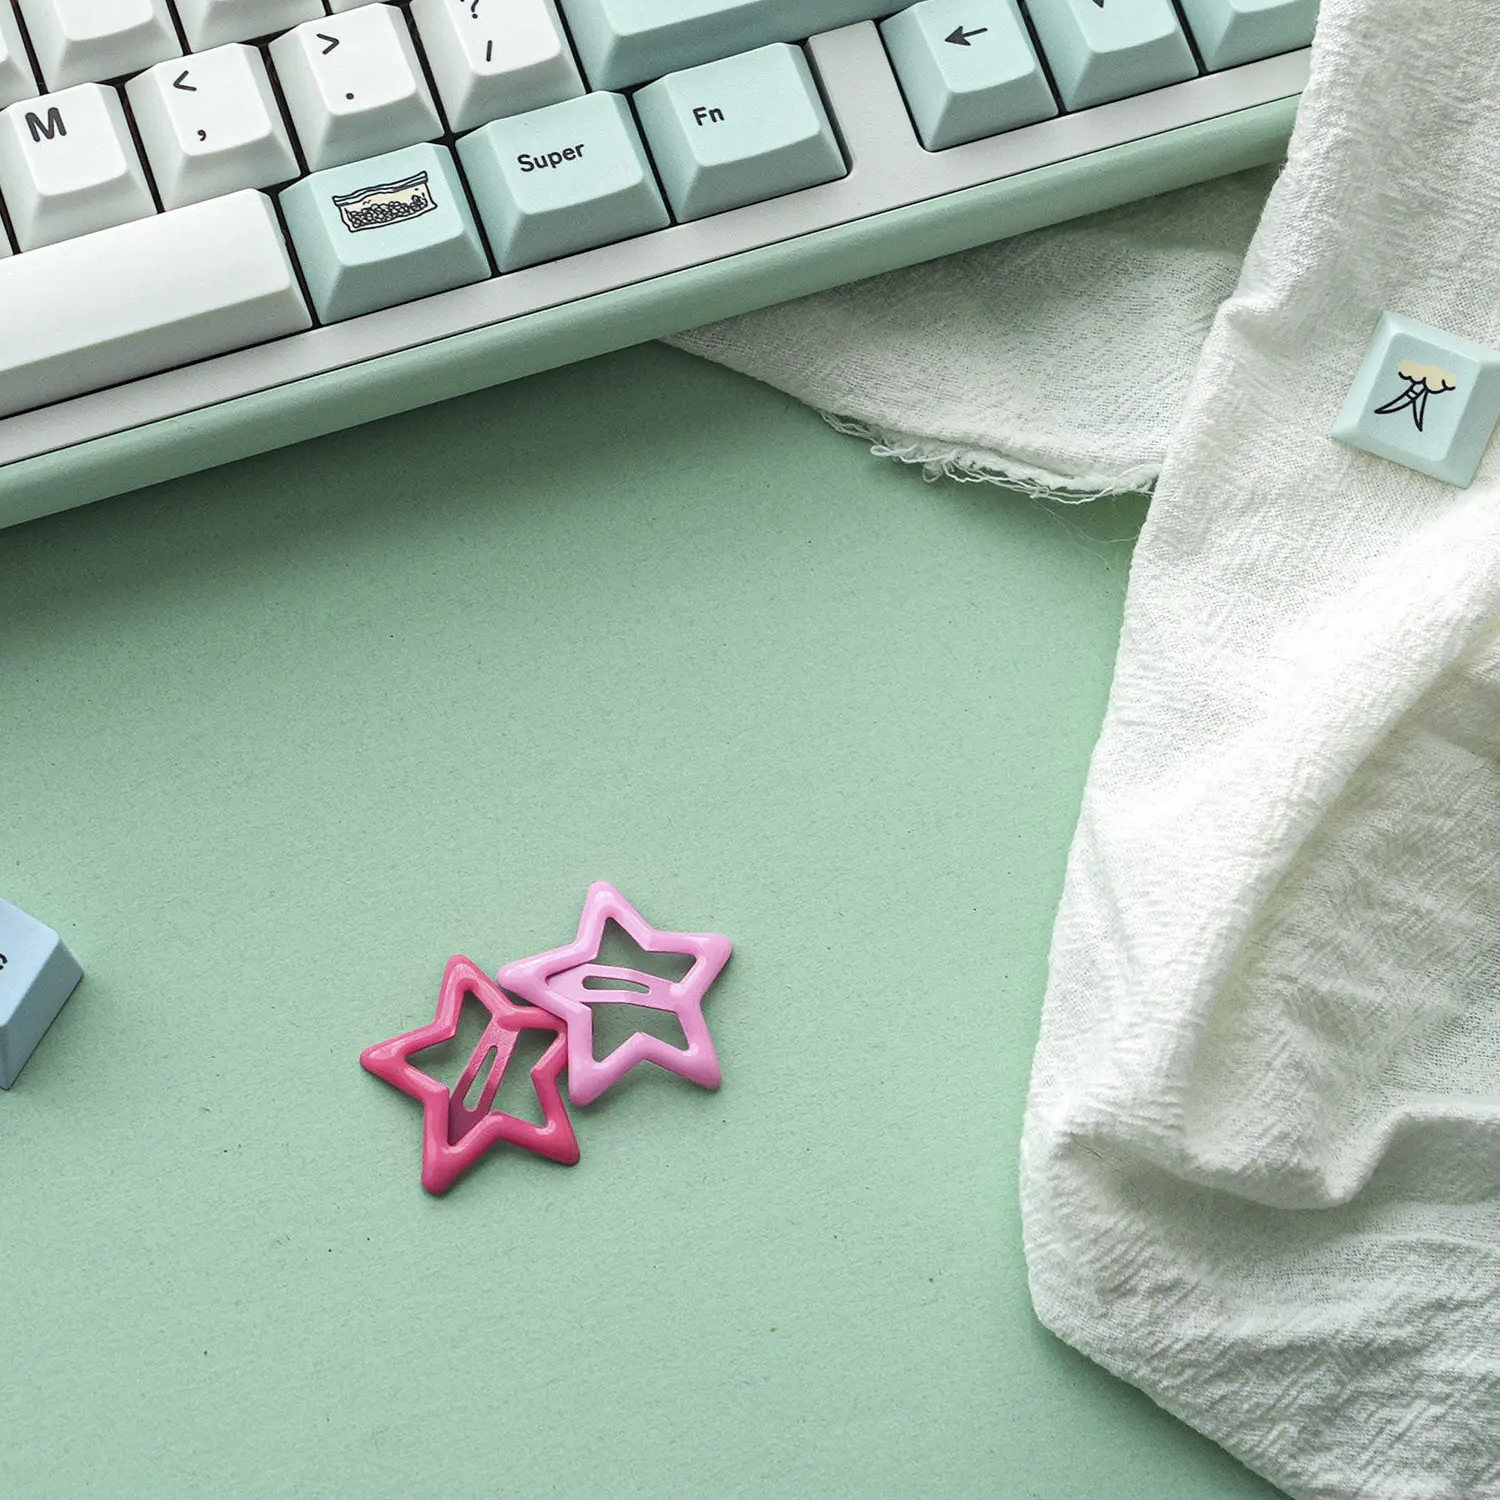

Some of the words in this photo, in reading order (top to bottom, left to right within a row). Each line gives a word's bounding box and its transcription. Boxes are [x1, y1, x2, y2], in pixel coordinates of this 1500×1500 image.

[316, 33, 340, 55] >
[173, 70, 197, 92] <
[24, 106, 67, 143] M
[692, 106, 725, 127] Fn
[517, 143, 585, 173] Super
